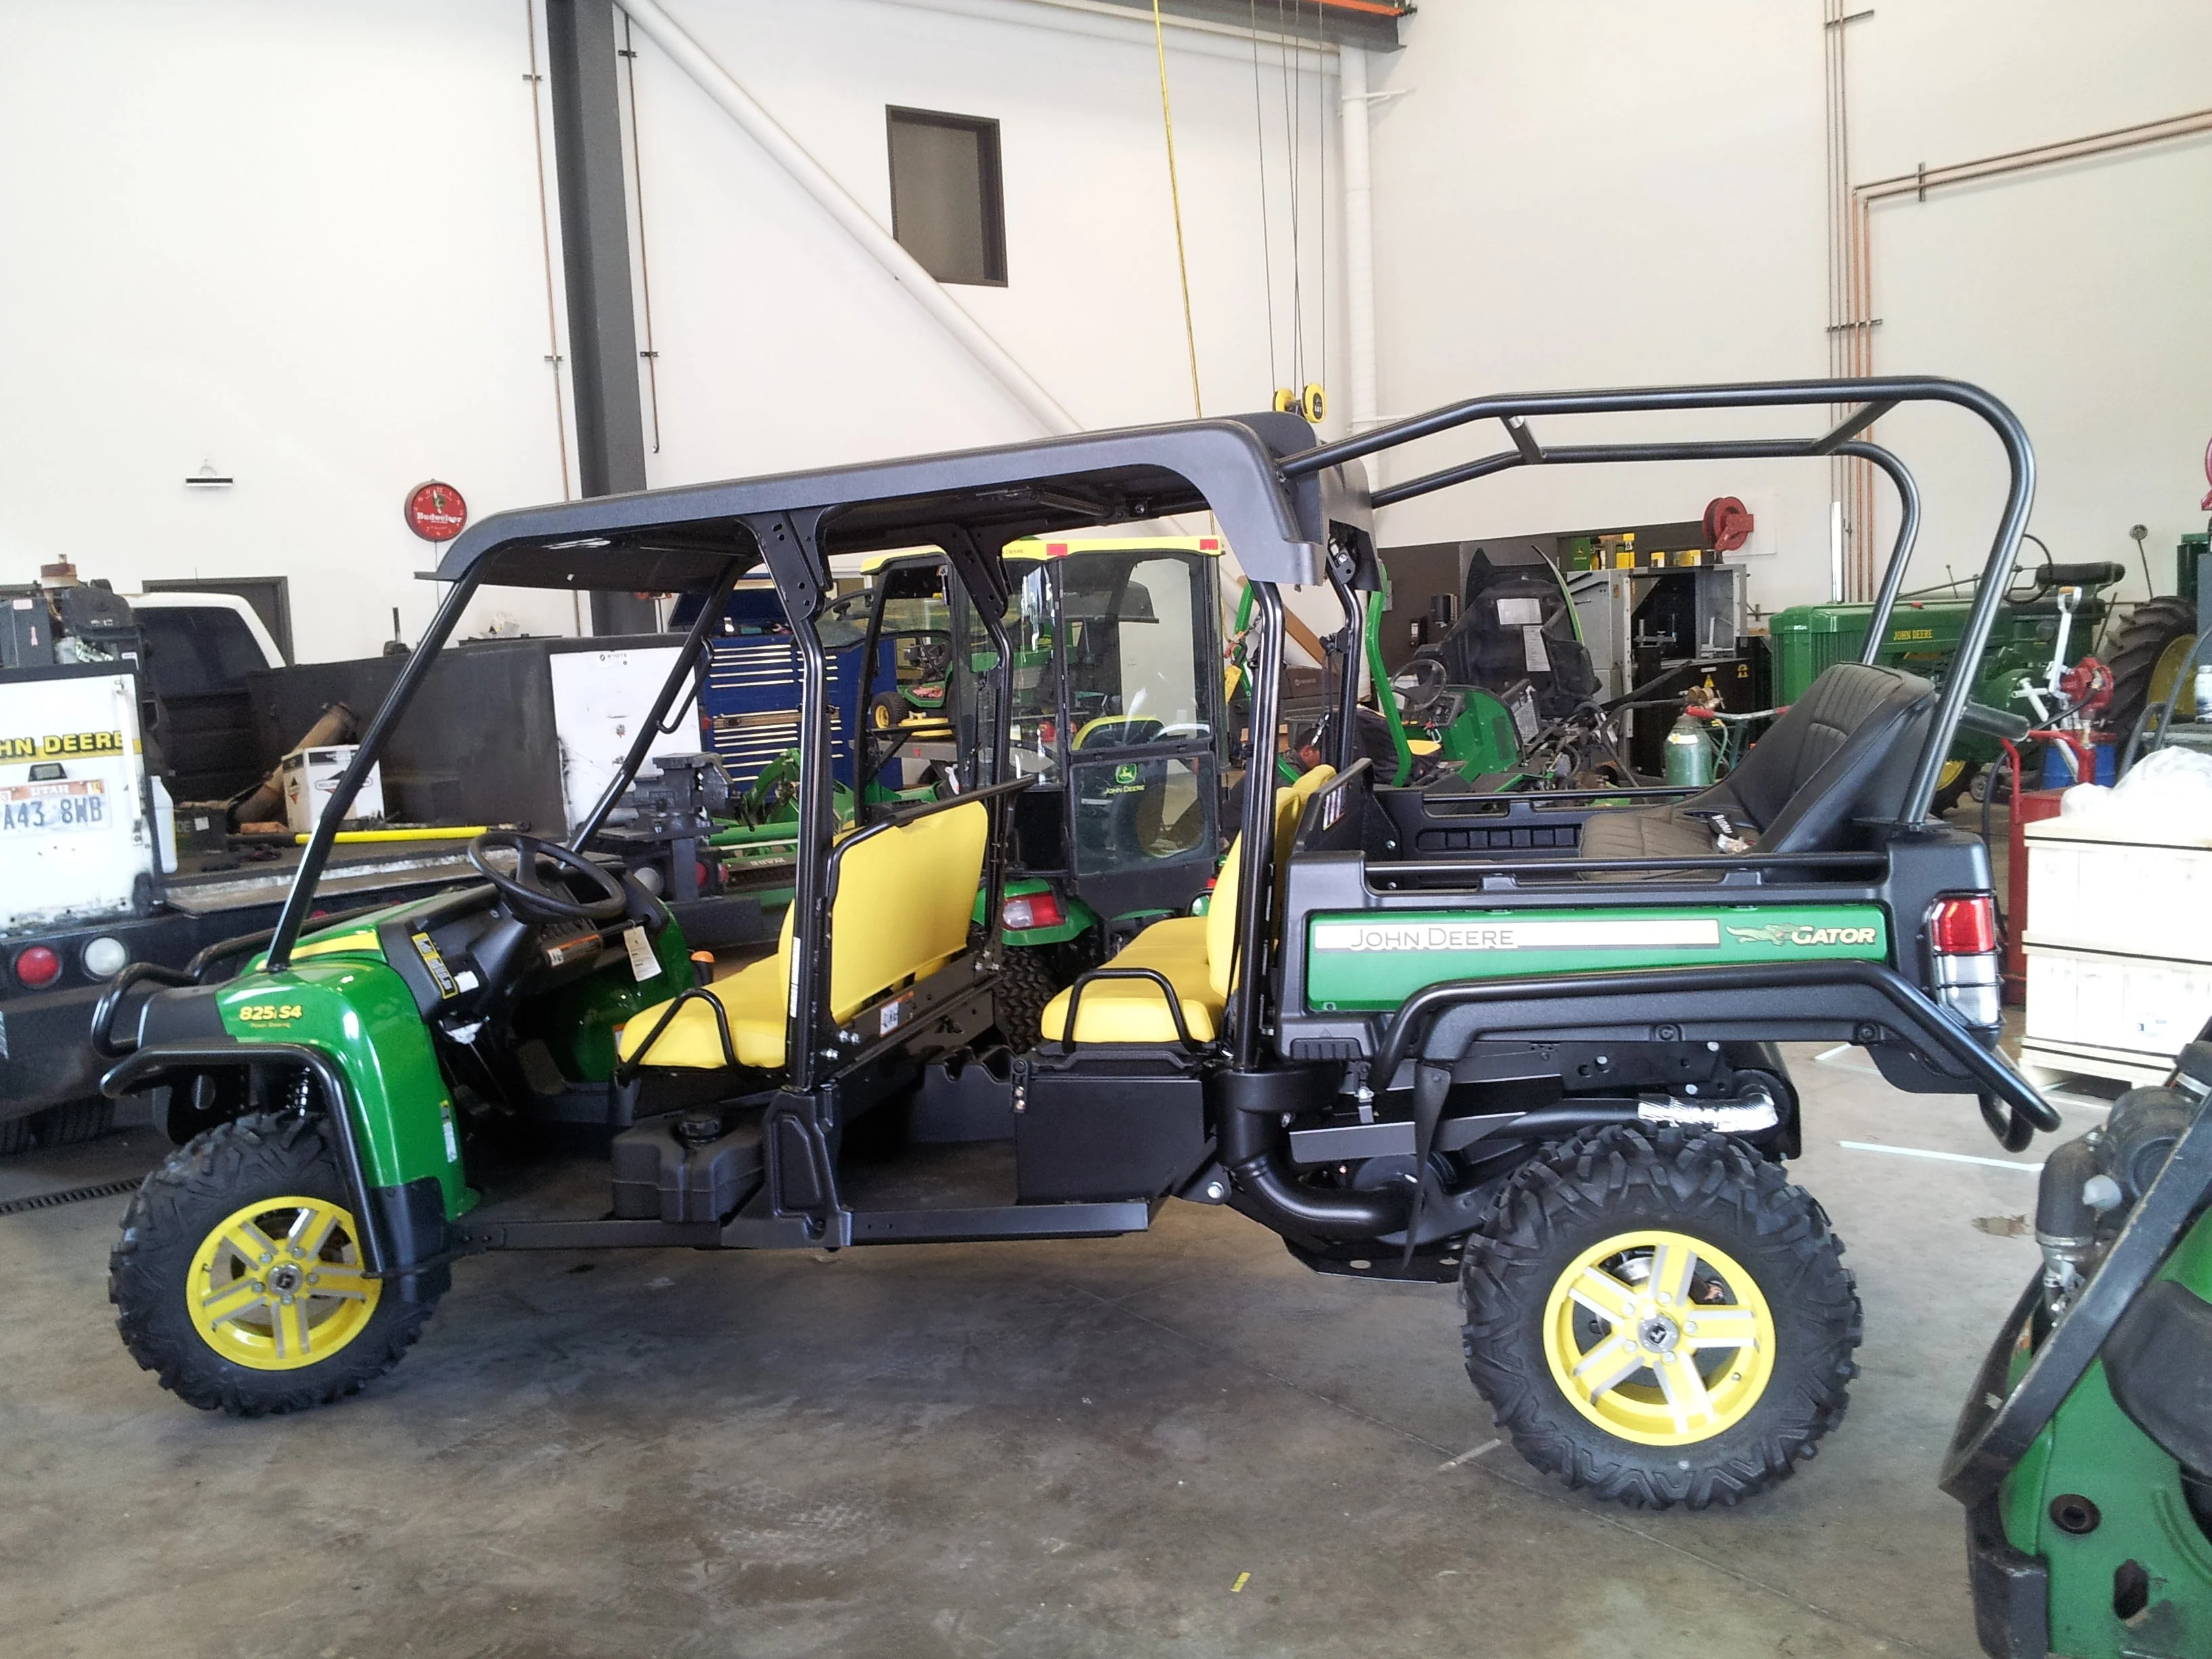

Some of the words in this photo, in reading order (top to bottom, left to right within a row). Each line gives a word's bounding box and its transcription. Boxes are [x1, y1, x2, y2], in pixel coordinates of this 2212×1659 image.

[417, 512, 462, 524] Budweiser
[1893, 630, 1911, 641] JOHN
[1912, 629, 1933, 639] DEERE
[43, 730, 123, 754] DEERE
[4, 801, 45, 830] A43
[60, 796, 102, 823] 8WB
[1351, 928, 1420, 947] JOHN
[1429, 928, 1514, 946] DEERE
[1791, 926, 1877, 945] GATOR
[279, 1005, 302, 1019] S4
